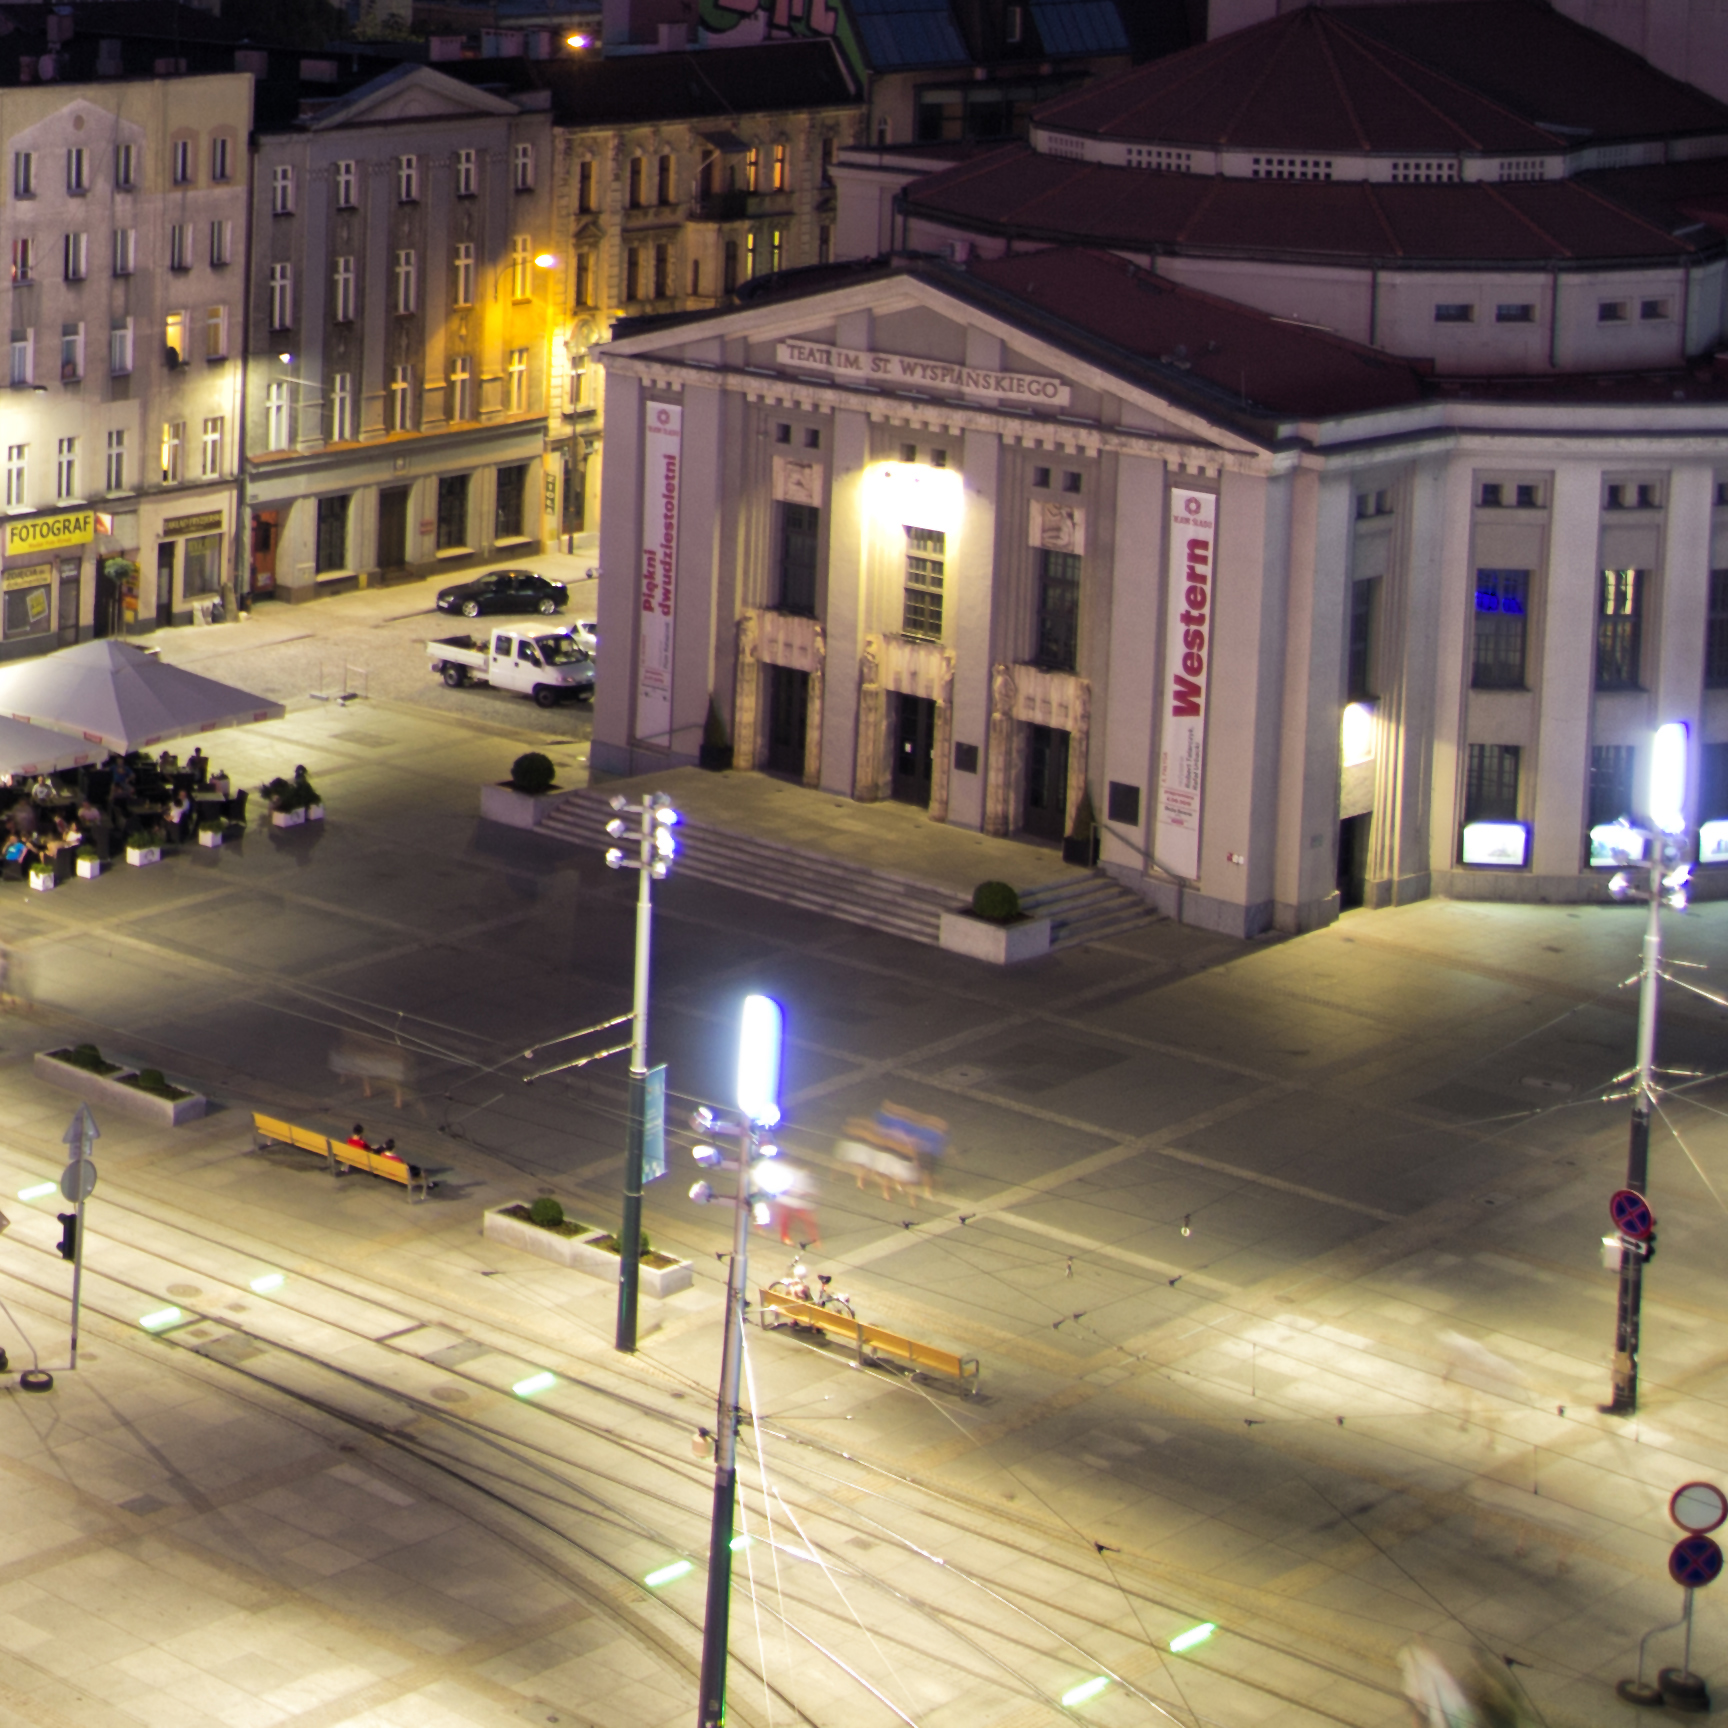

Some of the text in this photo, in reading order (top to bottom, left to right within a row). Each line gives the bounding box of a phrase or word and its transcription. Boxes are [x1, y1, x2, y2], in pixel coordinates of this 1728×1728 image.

[10, 515, 91, 544] FOTOGRAF
[658, 453, 677, 616] dwudziestoletni
[1171, 538, 1210, 717] Western
